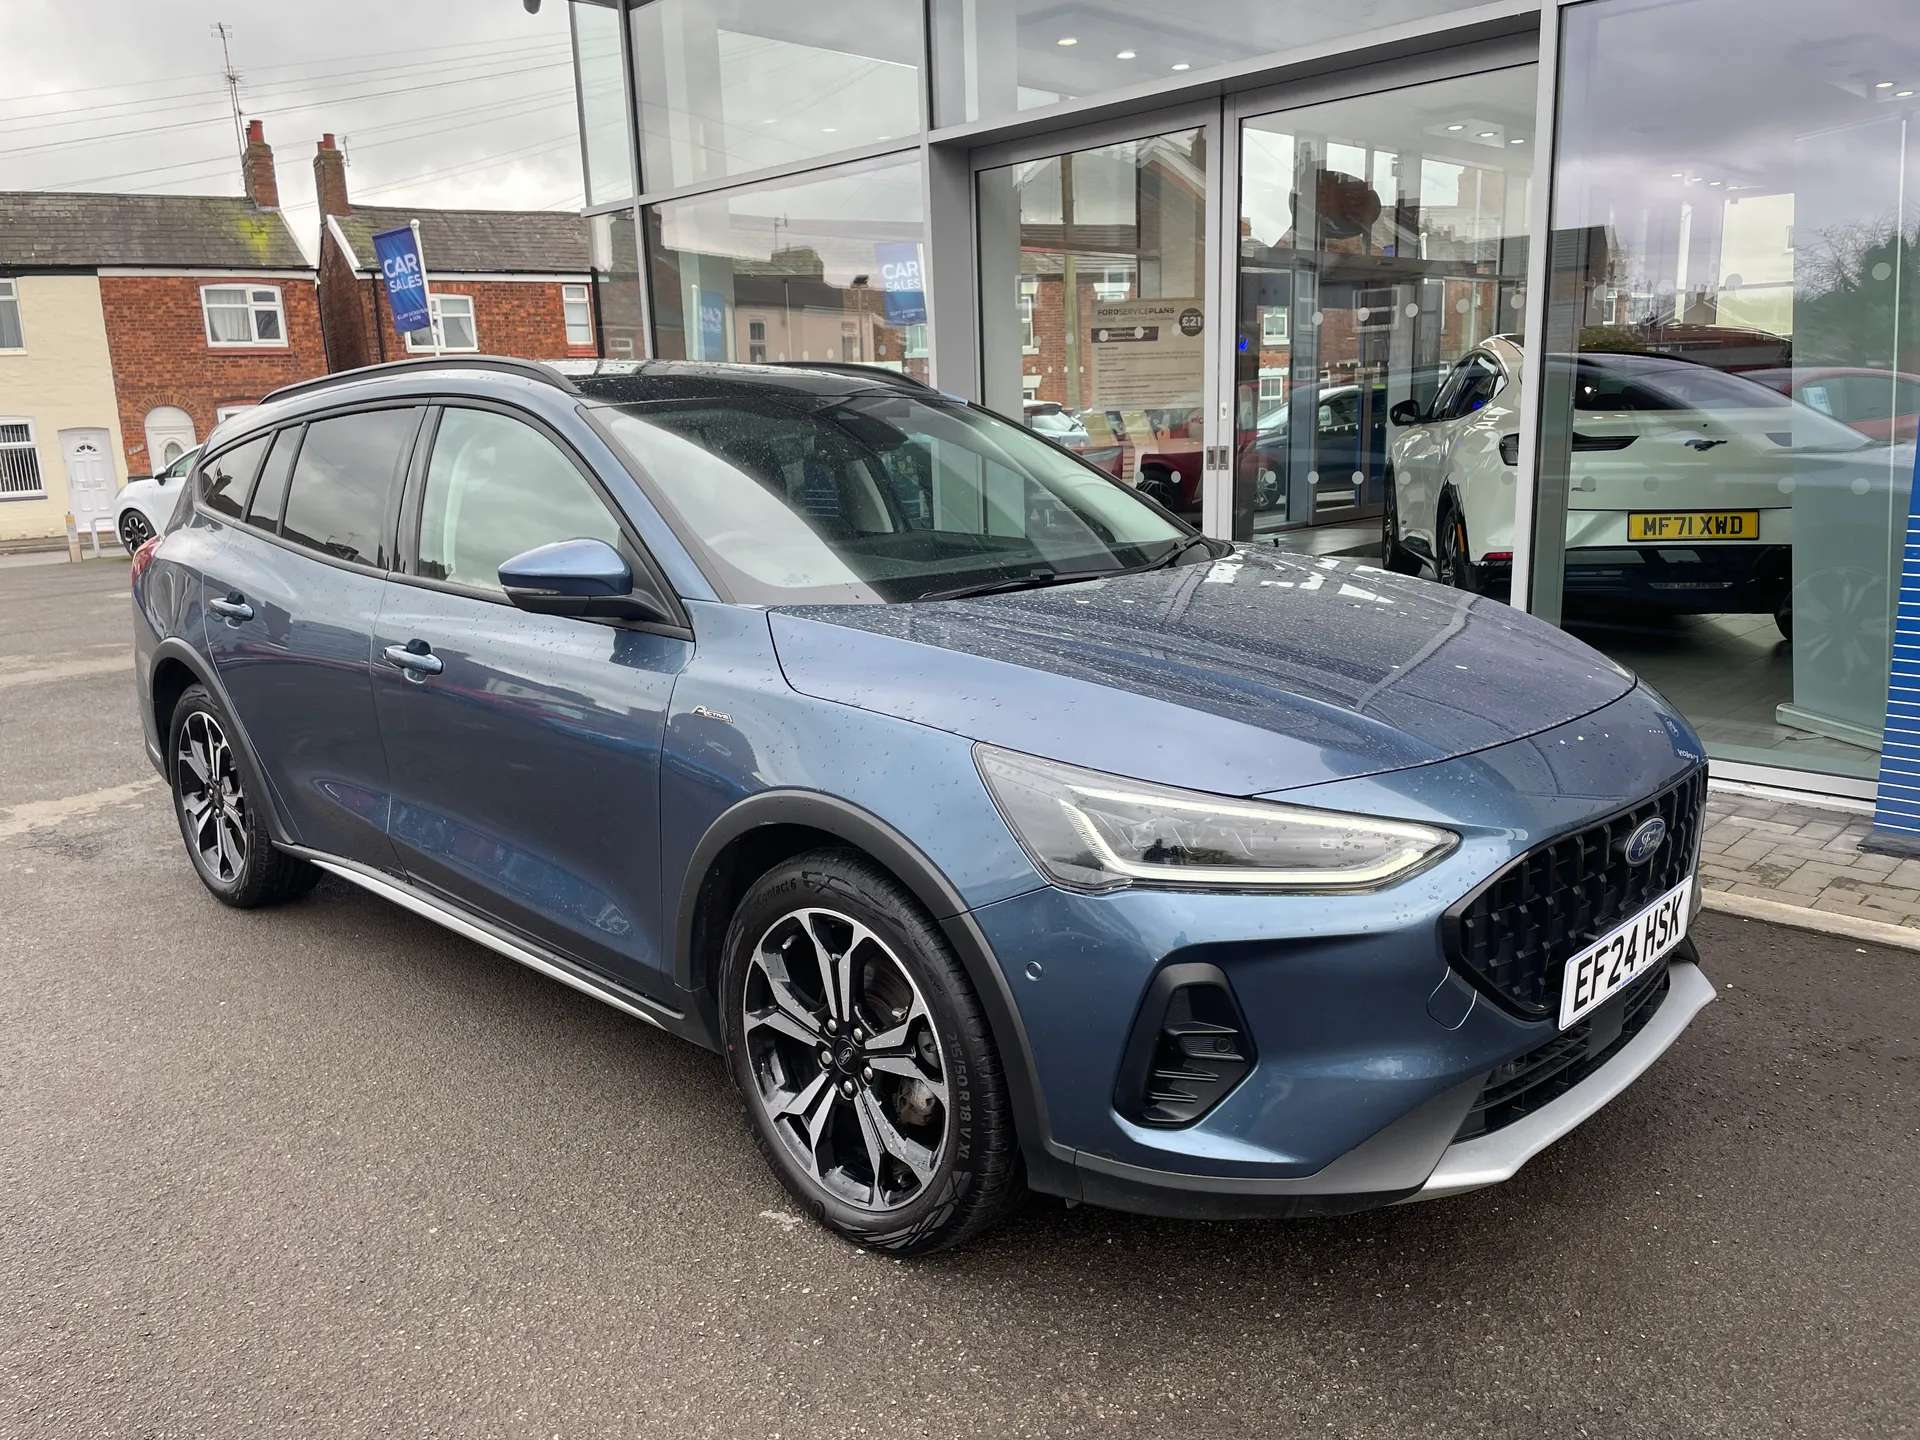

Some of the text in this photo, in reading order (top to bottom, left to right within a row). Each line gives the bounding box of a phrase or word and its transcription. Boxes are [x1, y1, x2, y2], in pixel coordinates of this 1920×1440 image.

[384, 252, 419, 278] CAR
[881, 260, 919, 279] CAR
[389, 274, 422, 293] SALES
[1182, 315, 1201, 327] £21
[1643, 516, 1743, 536] MF71 XWD
[1572, 889, 1684, 1014] EF24 HSK
